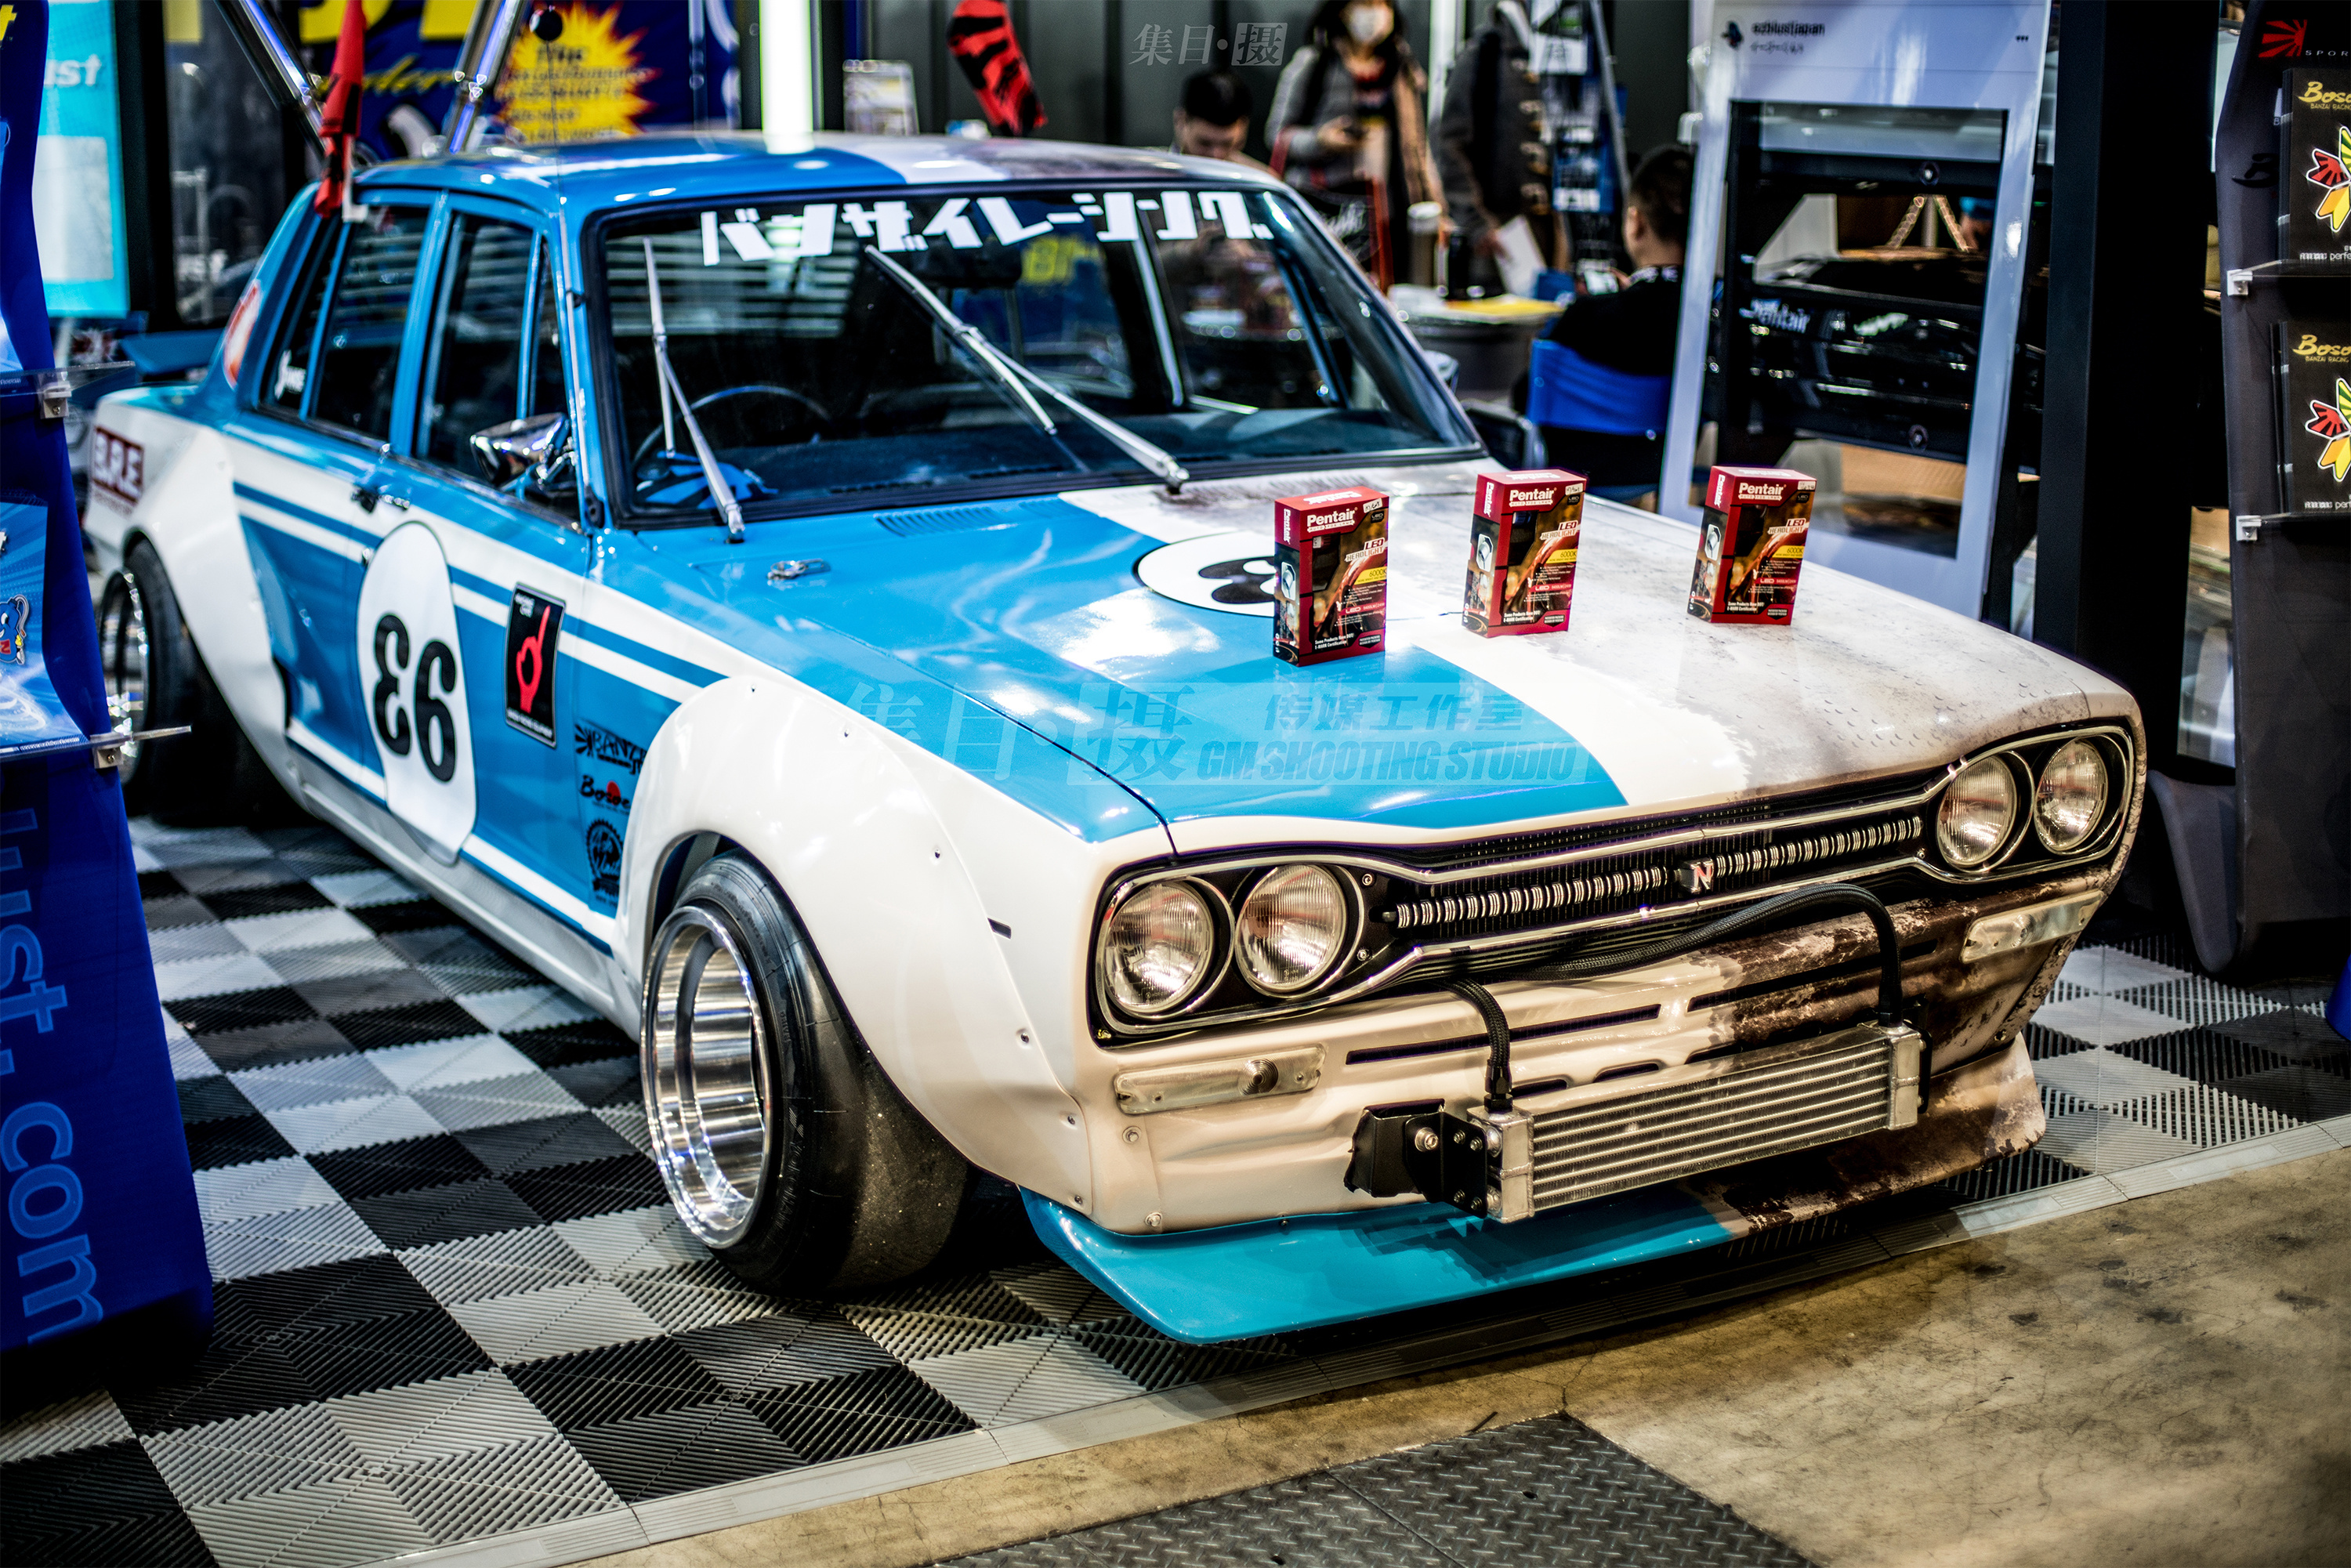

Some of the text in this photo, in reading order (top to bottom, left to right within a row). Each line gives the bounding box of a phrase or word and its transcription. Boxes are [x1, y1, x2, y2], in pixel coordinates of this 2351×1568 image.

[700, 190, 1274, 266] バンザイレーシング
[1739, 483, 1784, 494] Pentair
[1509, 488, 1554, 502] Pentair
[1307, 509, 1355, 527] Pentair
[1559, 521, 1578, 531] LED
[1541, 530, 1576, 539] HEADLIGHT
[1366, 538, 1385, 549] LED
[1346, 547, 1384, 561] HEADLIGHT
